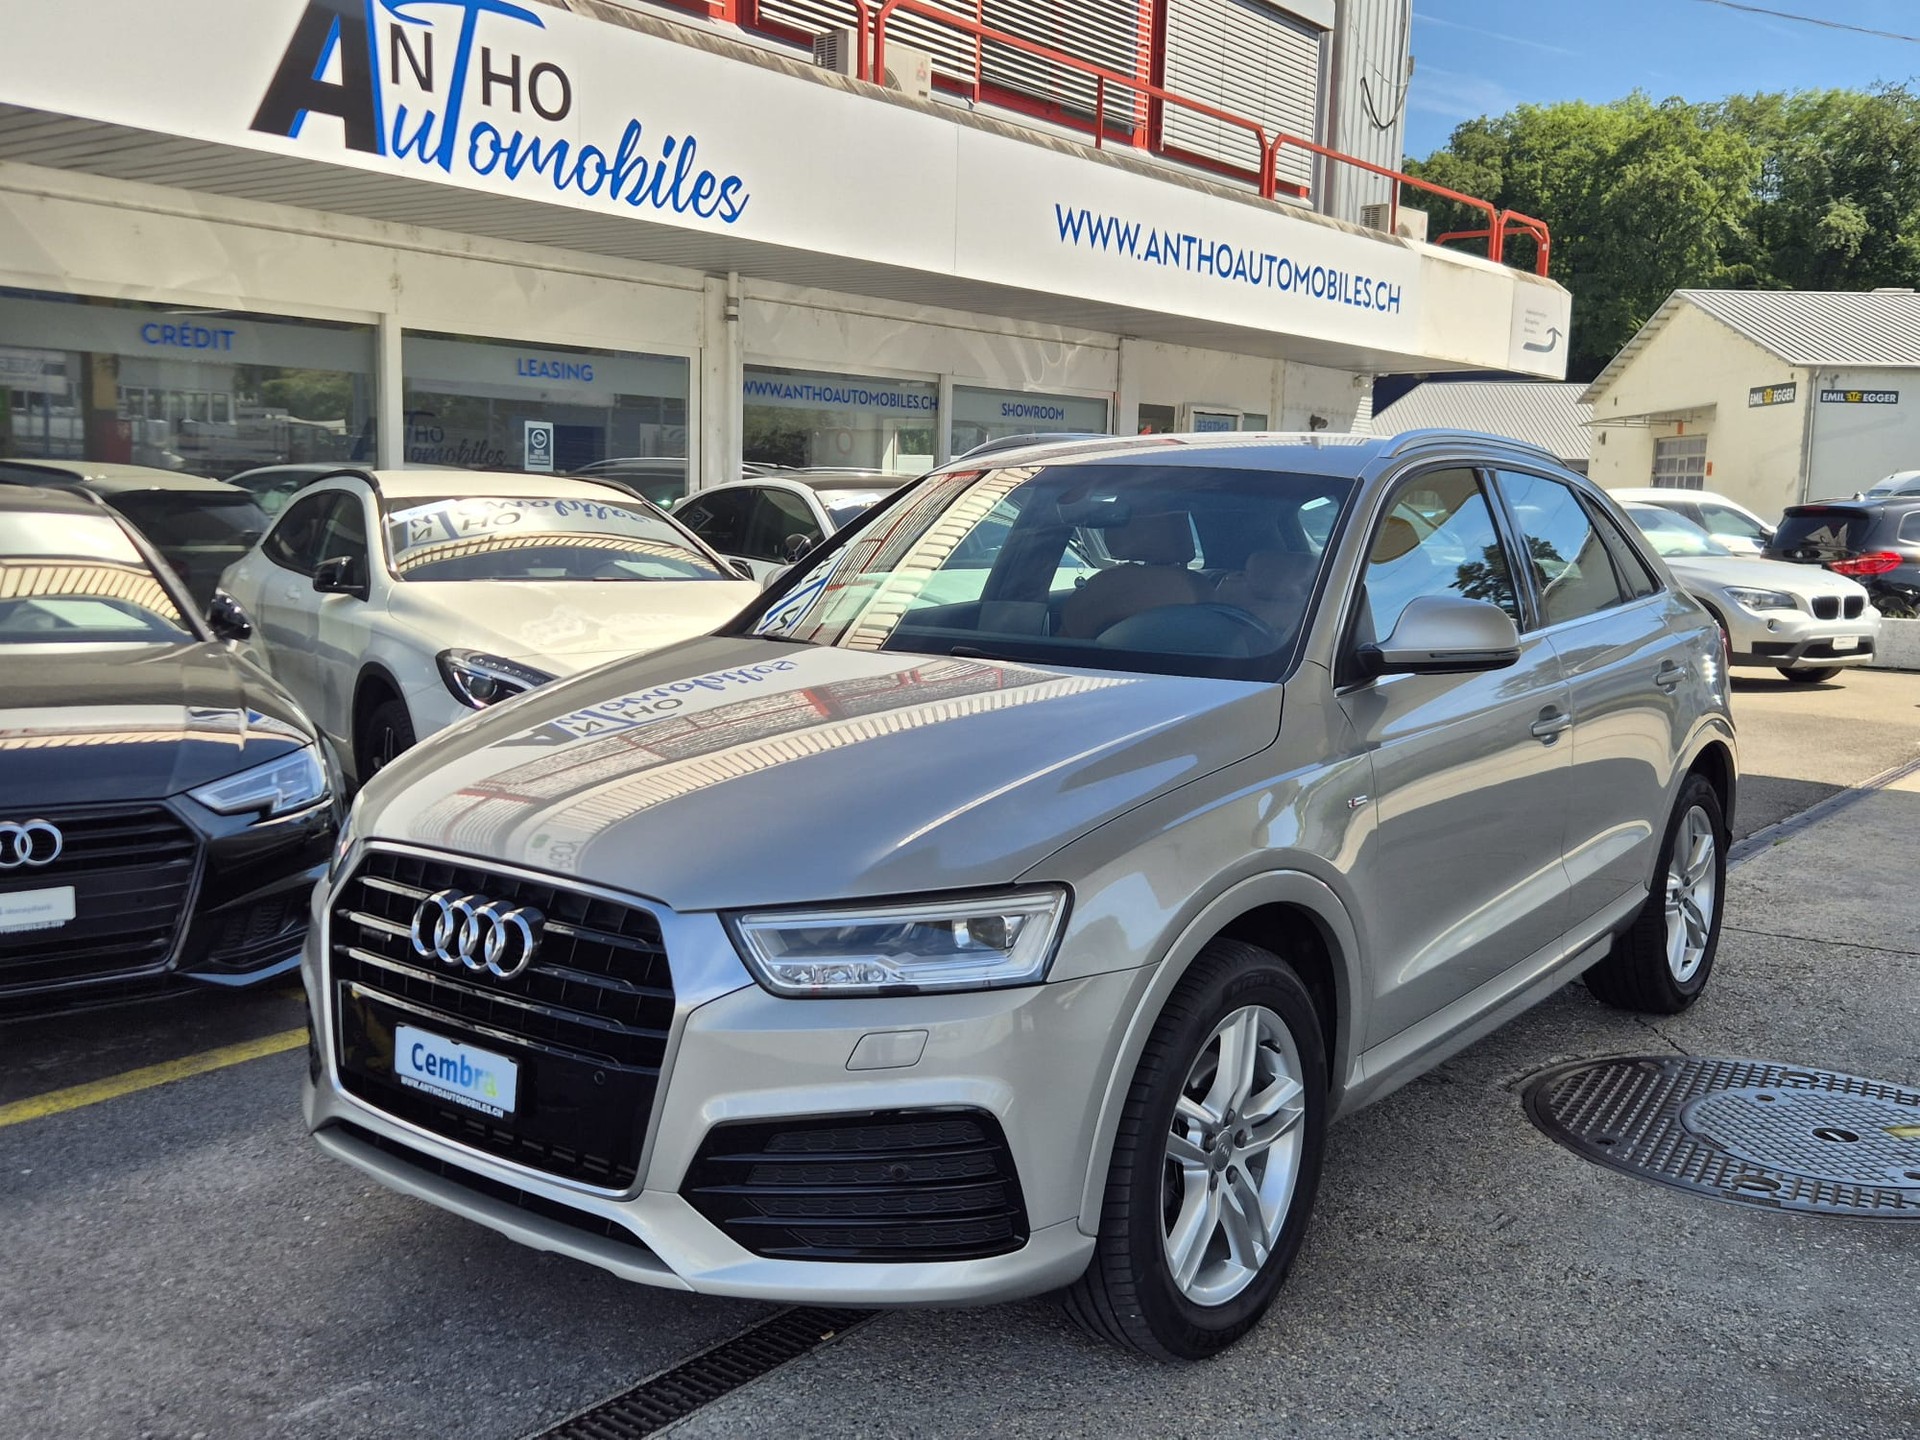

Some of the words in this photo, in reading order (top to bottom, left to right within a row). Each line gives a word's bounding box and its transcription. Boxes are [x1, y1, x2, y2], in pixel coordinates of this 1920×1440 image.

[1055, 203, 1401, 314] WWW.ANTHOAUTOMOBILES.CH
[141, 321, 236, 350] CRÉDIT
[517, 357, 595, 382] LEASING
[743, 380, 939, 411] WWW.ANTHOAUTOMOBILES.CH
[1750, 392, 1763, 405] EMIL
[1773, 388, 1795, 402] EGGER
[1822, 392, 1846, 402] EMIL
[1863, 393, 1897, 403] EGGER
[1001, 402, 1065, 420] SHOWROOM
[412, 1042, 498, 1098] Cembra
